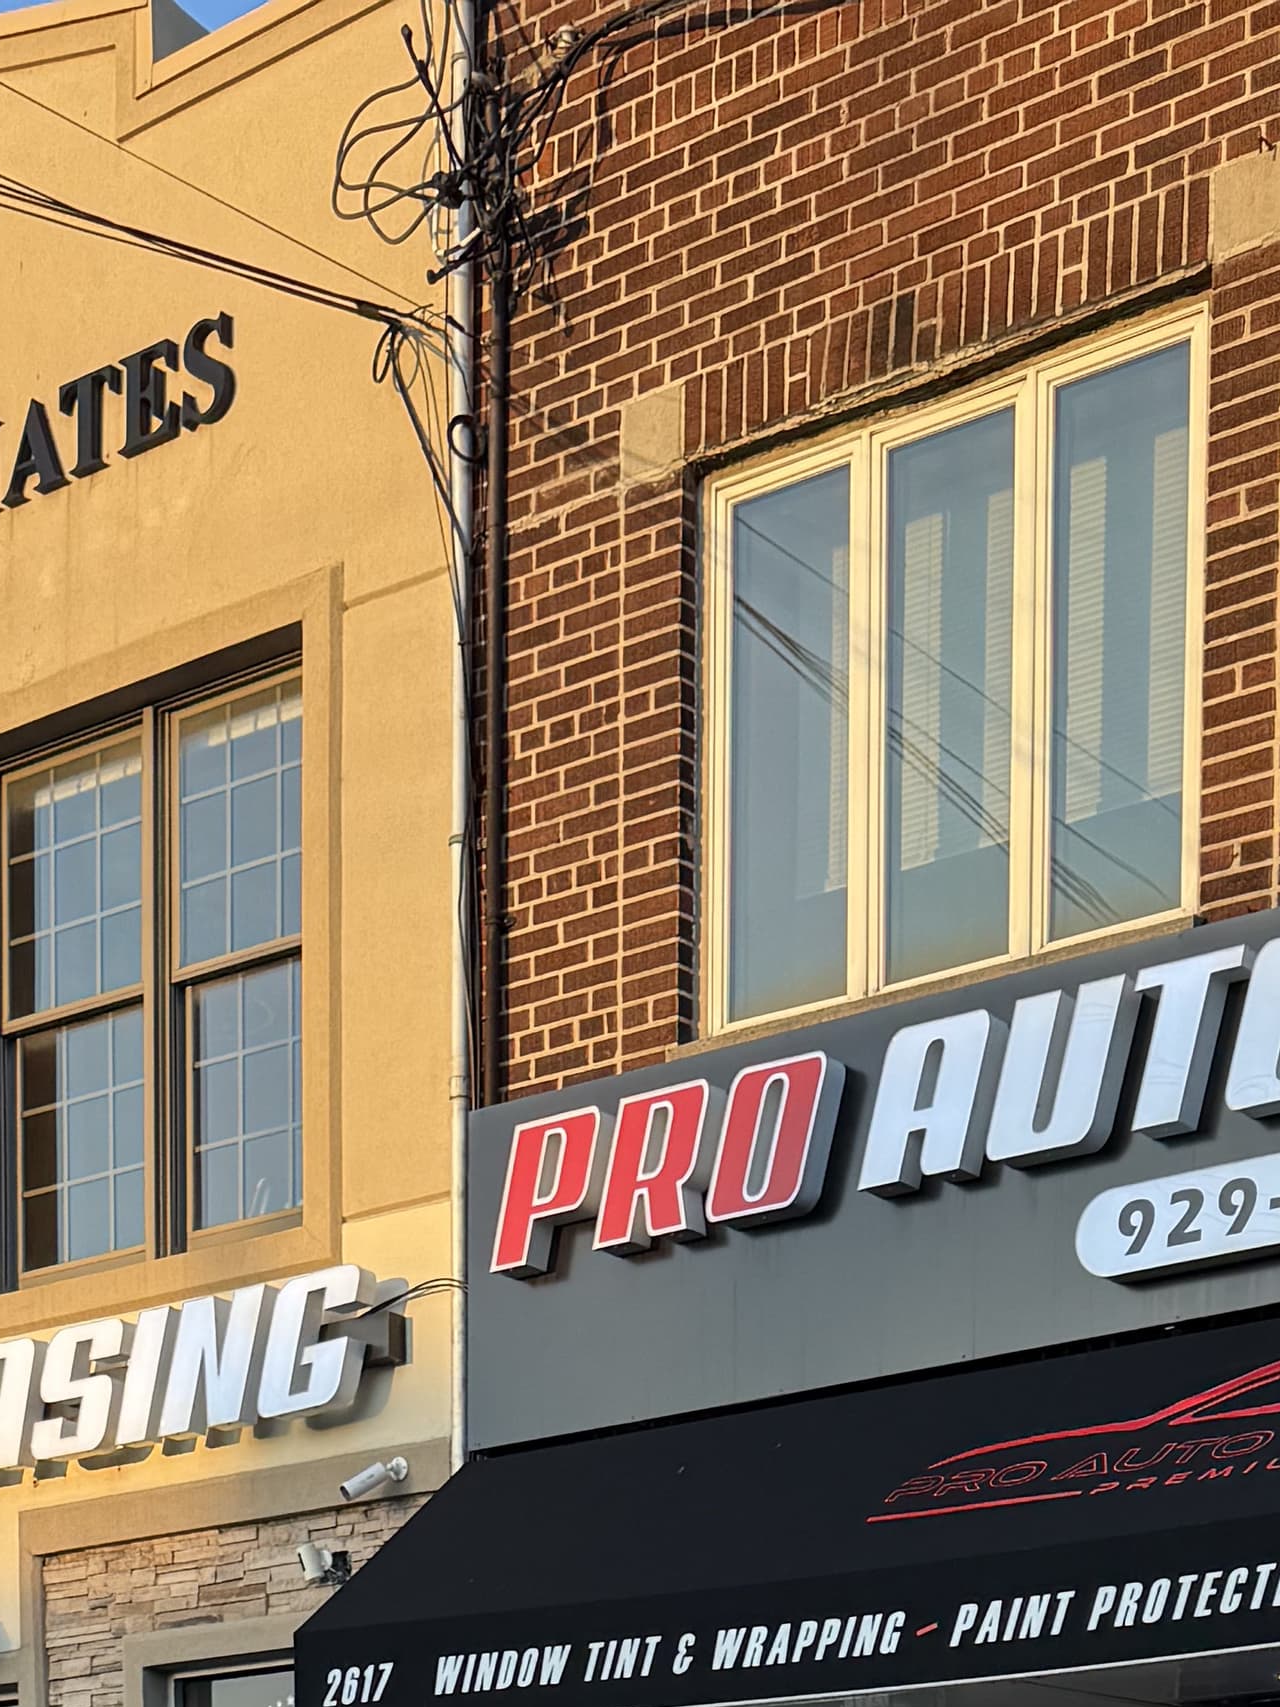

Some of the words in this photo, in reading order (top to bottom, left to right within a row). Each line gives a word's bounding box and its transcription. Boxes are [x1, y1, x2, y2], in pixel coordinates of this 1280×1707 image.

[489, 1050, 842, 1278] PRO
[884, 1459, 1049, 1505] PRO
[1066, 1429, 1277, 1481] AUTO
[322, 1662, 394, 1707] 2617
[433, 1643, 572, 1698] WINDOW
[583, 1635, 664, 1683] TINT
[670, 1632, 696, 1676] &
[711, 1610, 907, 1670] WRAPPING
[948, 1590, 1076, 1649] PAINT
